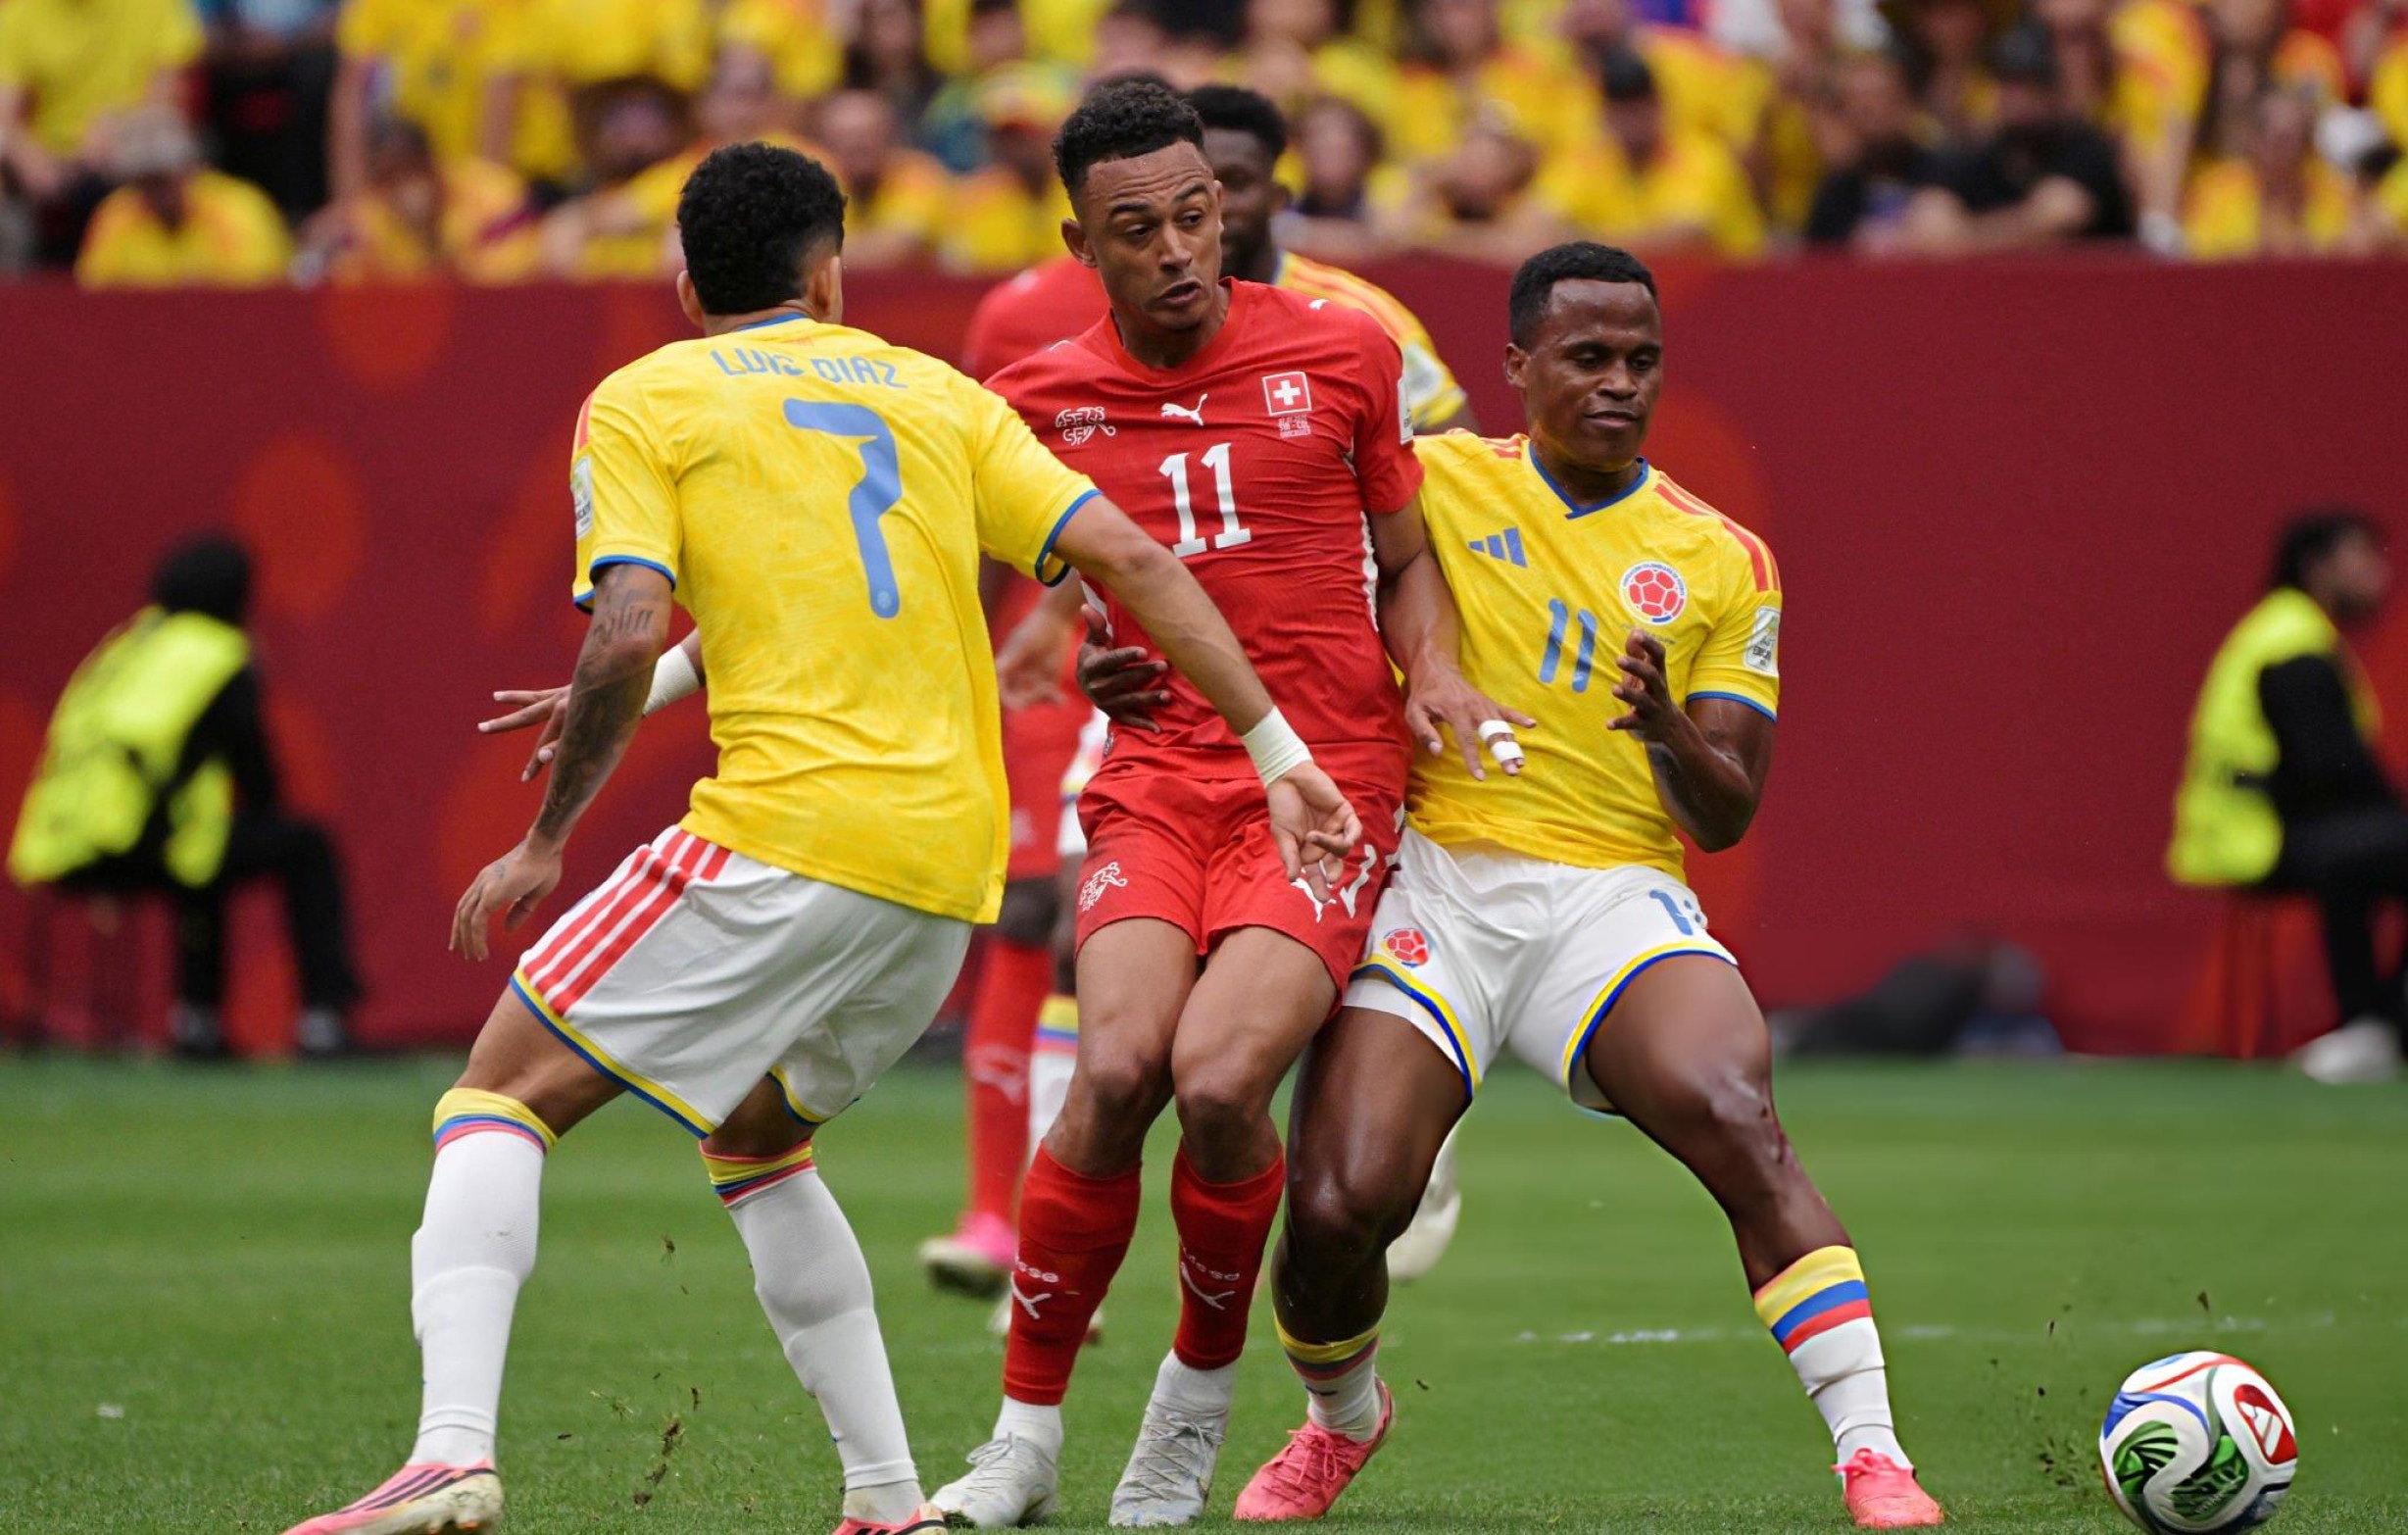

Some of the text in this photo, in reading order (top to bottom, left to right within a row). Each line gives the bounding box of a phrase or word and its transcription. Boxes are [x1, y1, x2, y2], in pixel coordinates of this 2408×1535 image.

[811, 356, 909, 388] DIAZ
[782, 397, 903, 619] 7
[1158, 442, 1252, 560] 11
[1538, 599, 1597, 693] 11
